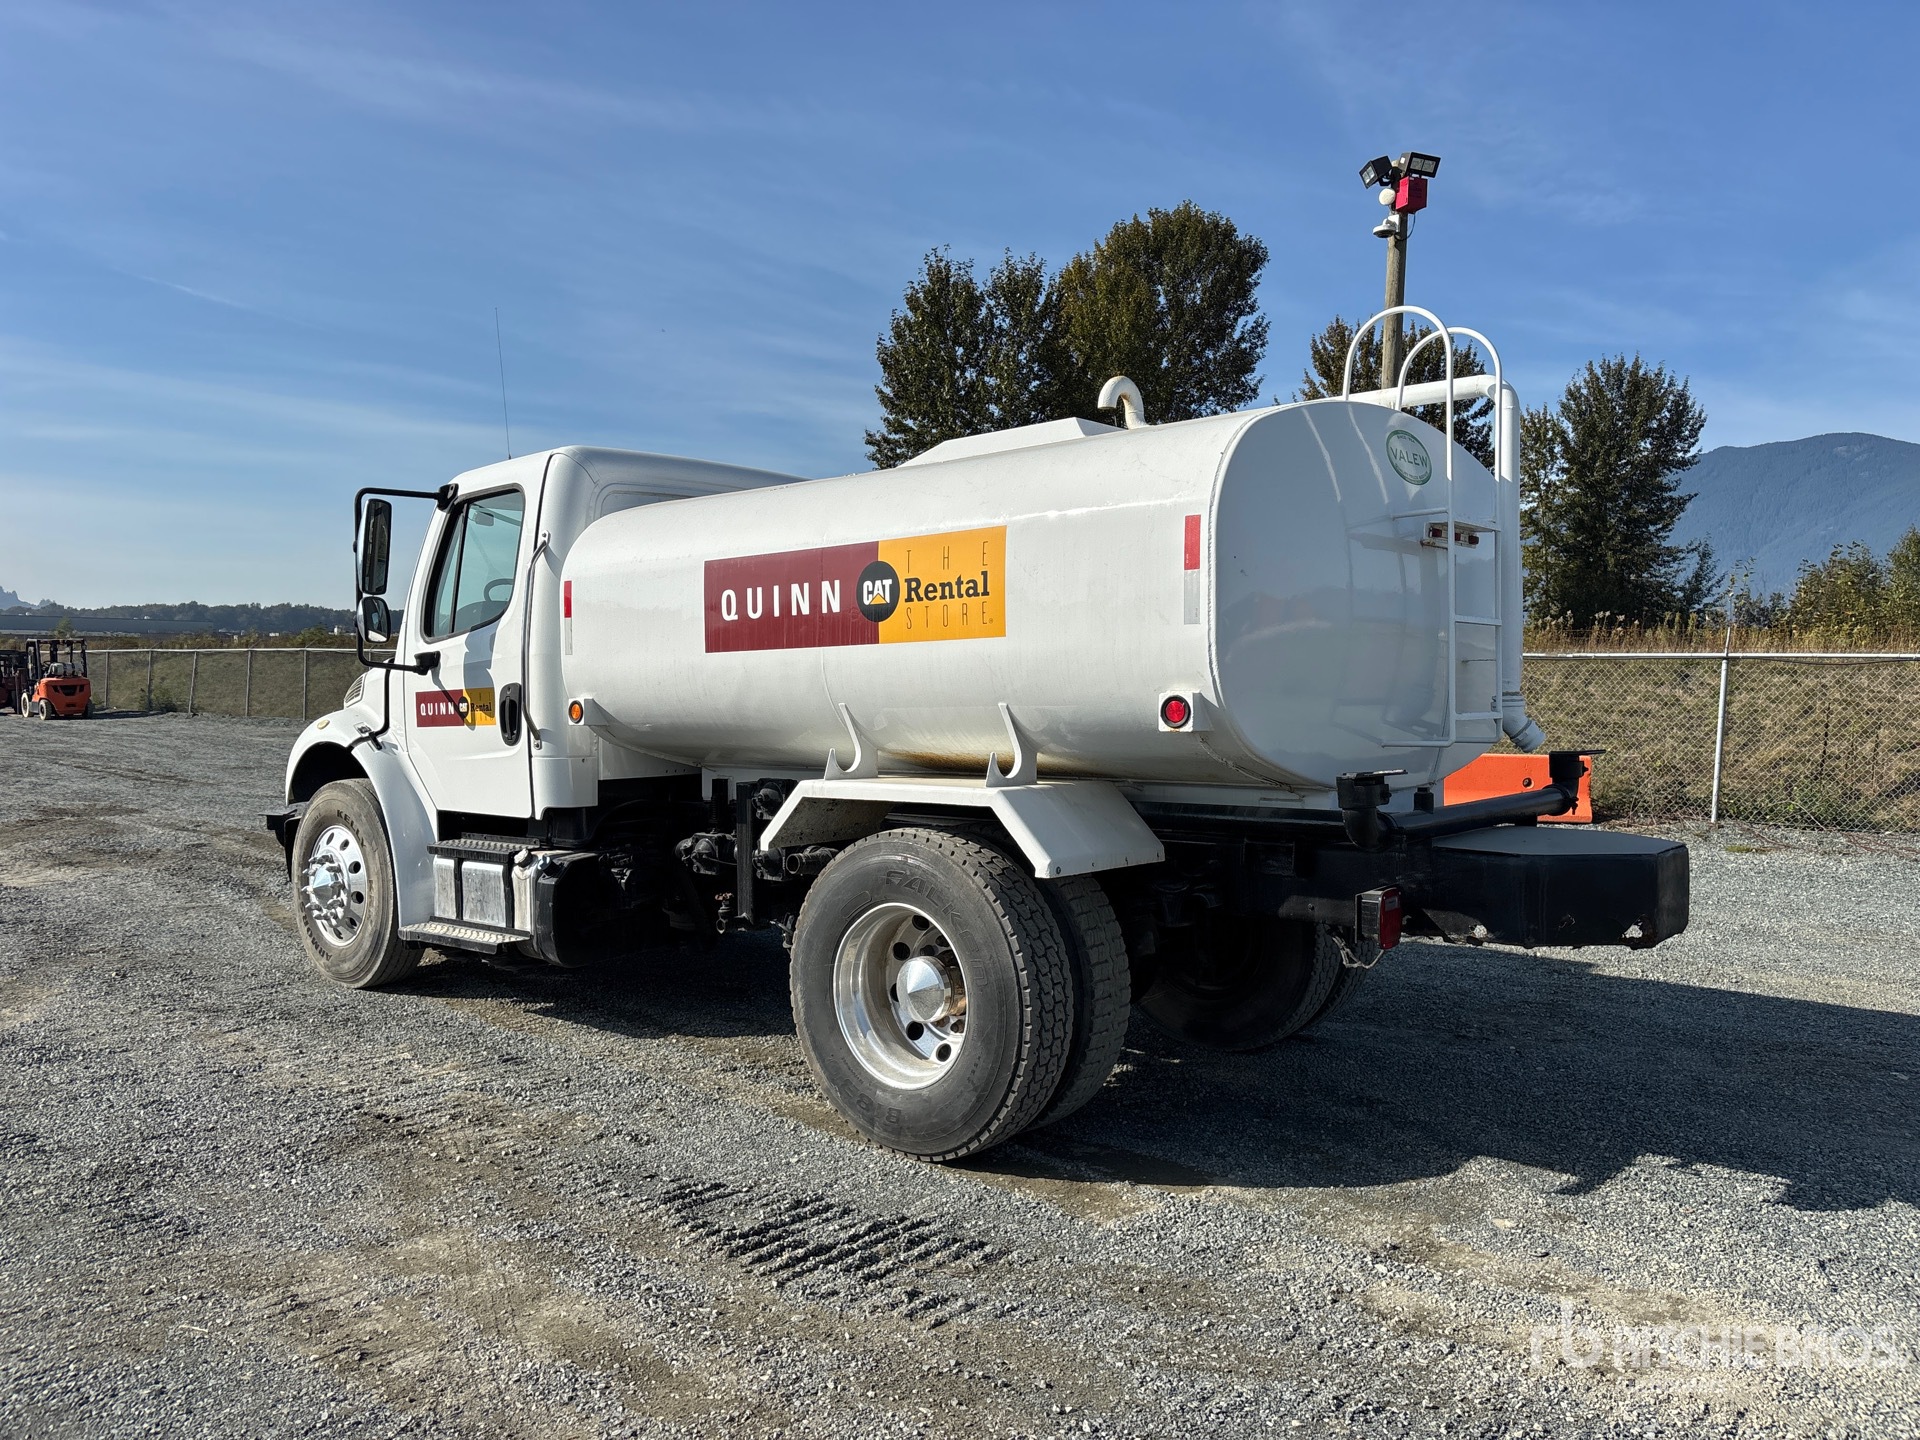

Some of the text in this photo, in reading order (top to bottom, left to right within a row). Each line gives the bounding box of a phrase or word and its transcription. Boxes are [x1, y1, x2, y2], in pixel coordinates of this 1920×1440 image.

[1390, 446, 1428, 468] VALEW
[906, 541, 989, 574] THE
[720, 579, 841, 622] QUINN
[862, 578, 893, 605] CAT
[904, 570, 990, 603] Rental
[420, 701, 455, 716] QUINN
[470, 702, 492, 712] Rental
[336, 809, 367, 848] KELLY
